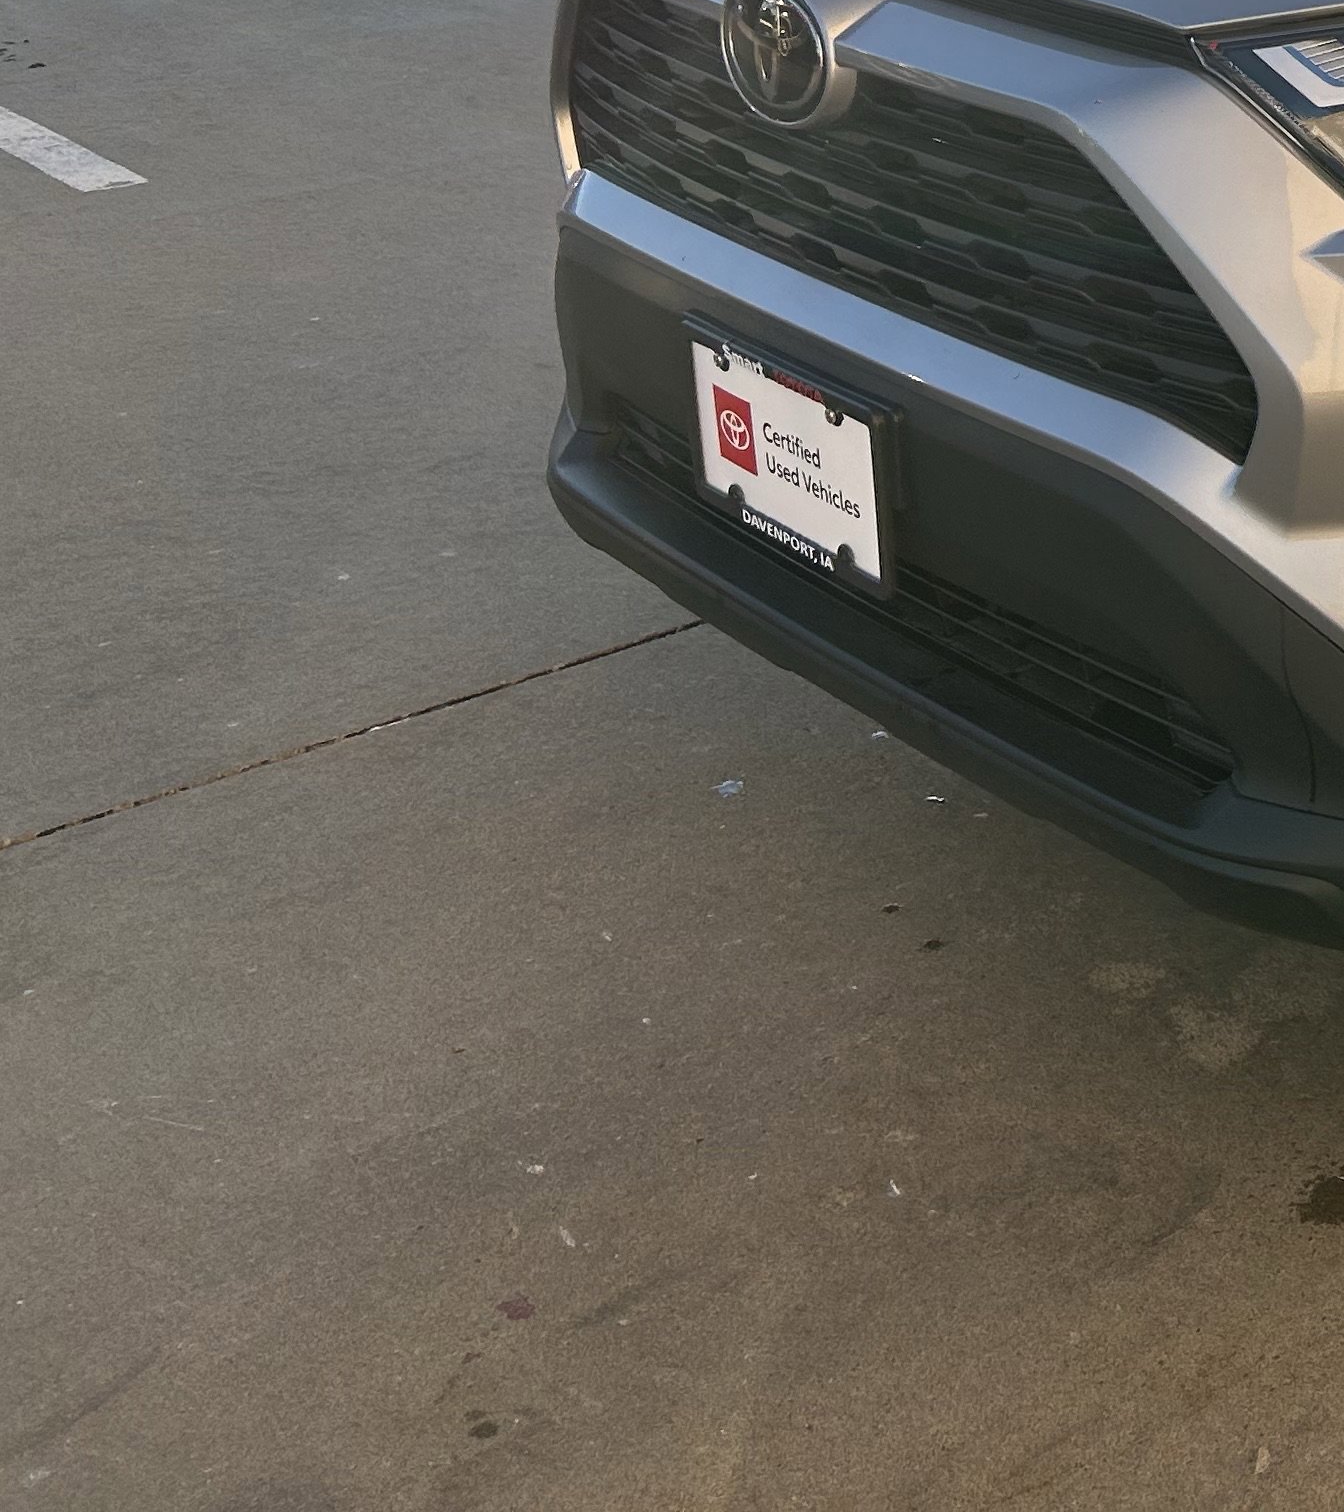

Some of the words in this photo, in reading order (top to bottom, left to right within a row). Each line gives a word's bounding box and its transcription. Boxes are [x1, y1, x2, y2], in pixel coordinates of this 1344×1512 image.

[722, 343, 765, 376] Smart
[763, 422, 821, 469] Certified
[766, 452, 800, 488] Used
[802, 471, 861, 519] Vehicles
[742, 508, 818, 564] DAVENPORT,
[820, 553, 834, 572] IA
